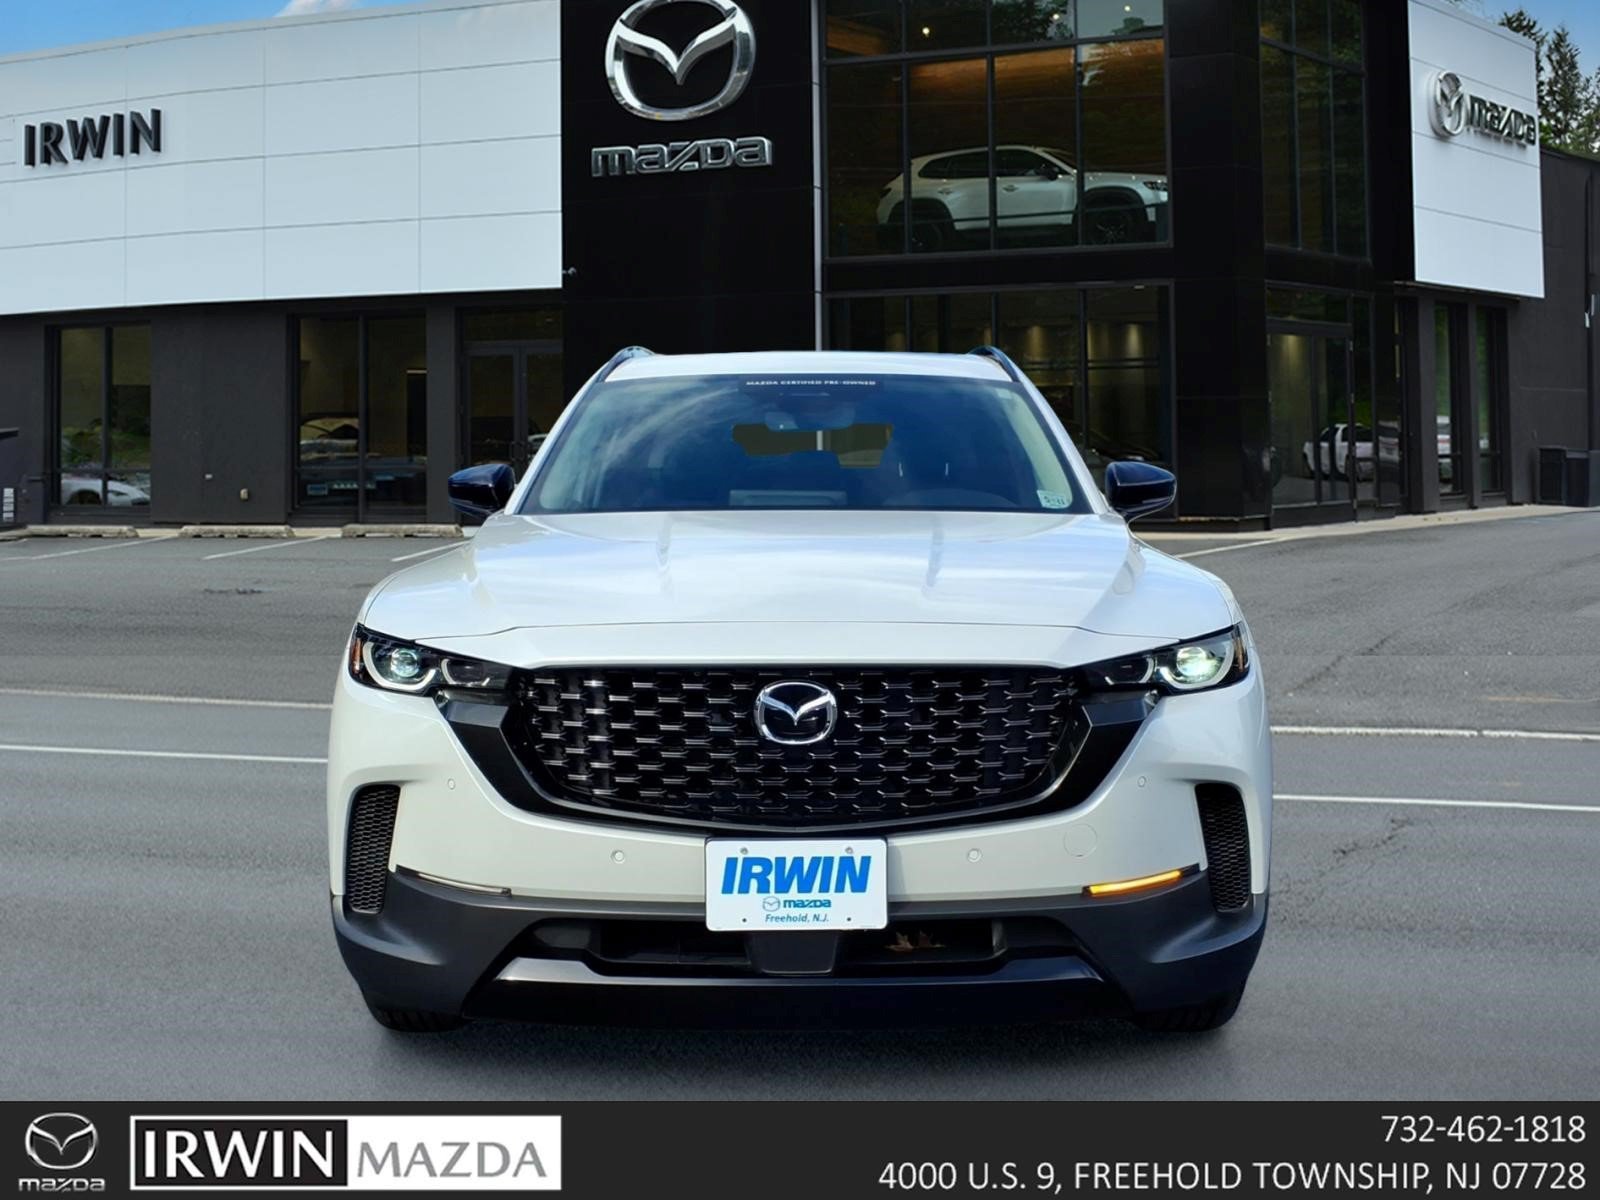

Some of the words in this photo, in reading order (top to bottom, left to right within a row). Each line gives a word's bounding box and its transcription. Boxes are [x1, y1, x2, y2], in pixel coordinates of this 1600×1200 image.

[24, 108, 162, 167] IRWIN
[1467, 93, 1537, 146] mazda
[591, 136, 773, 177] mazda
[721, 855, 872, 895] IRWIN
[765, 913, 810, 923] Freehold,
[812, 914, 829, 922] N.J.
[783, 899, 832, 909] mazda
